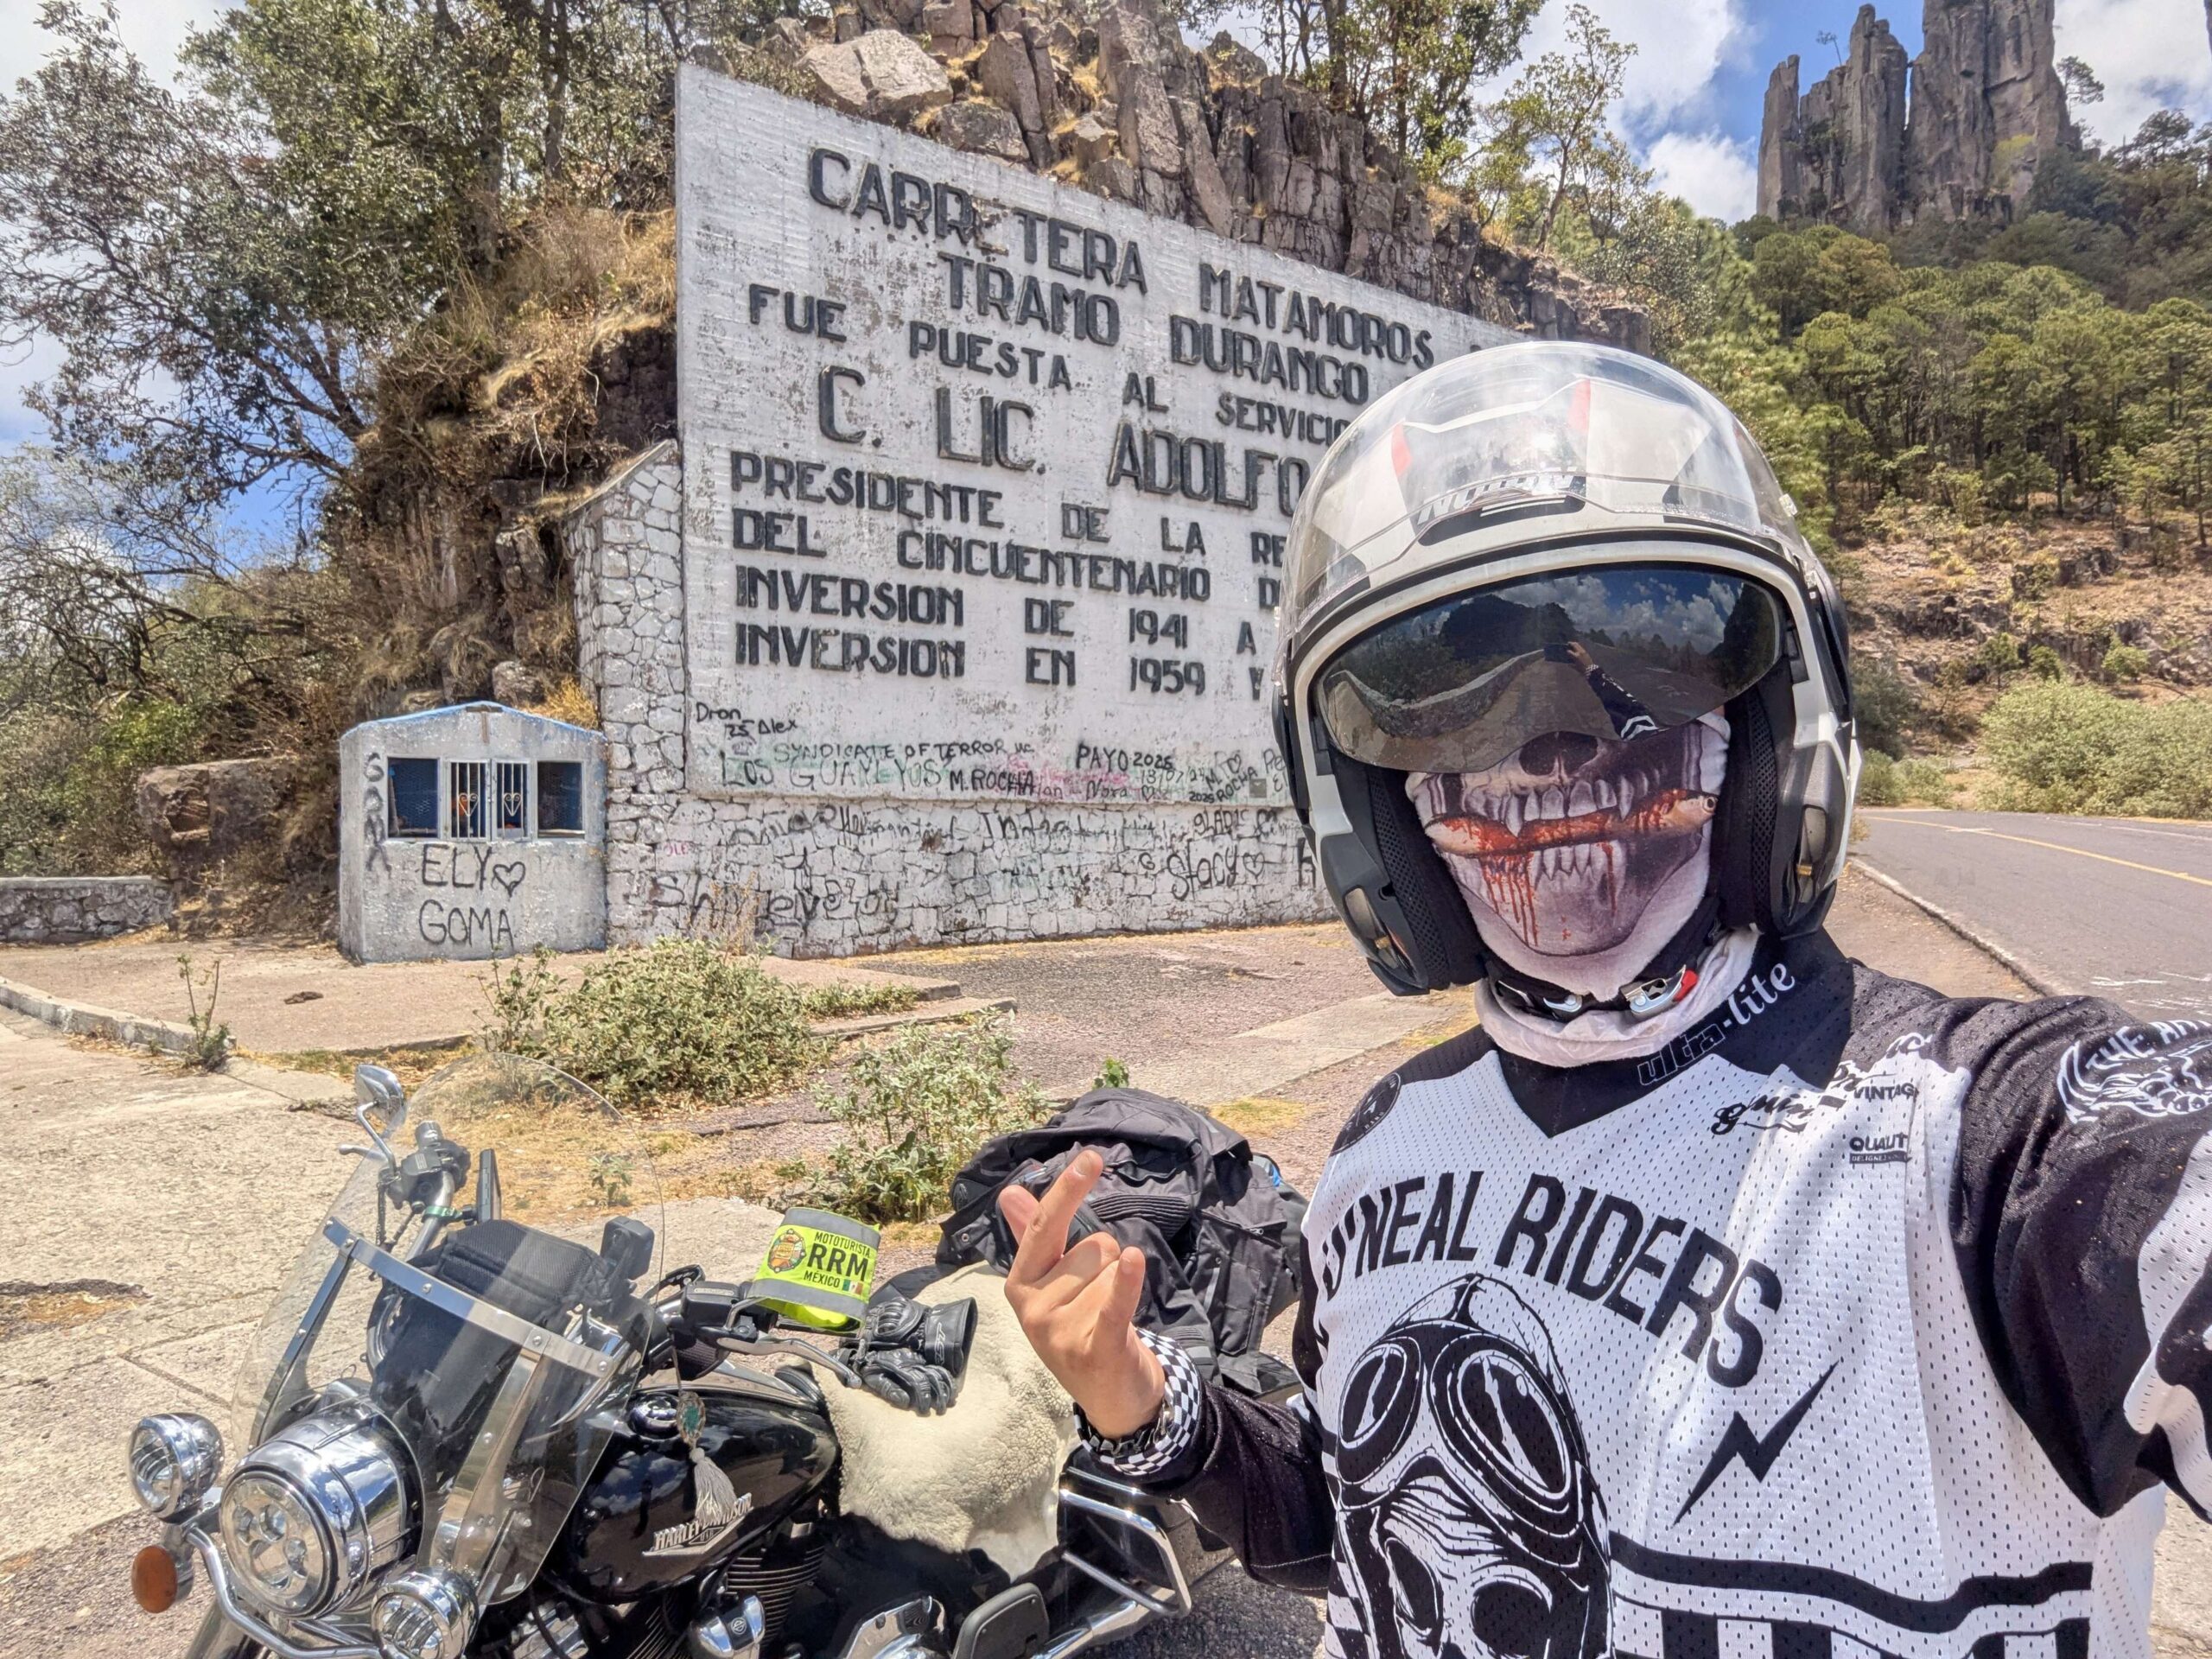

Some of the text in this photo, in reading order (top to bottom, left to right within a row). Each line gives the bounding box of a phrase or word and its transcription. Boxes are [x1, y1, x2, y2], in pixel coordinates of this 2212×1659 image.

[749, 283, 847, 342] FUE
[910, 321, 1071, 391] PUESTA
[1123, 372, 1169, 412] AL
[938, 251, 1369, 405] TRAMO DURANGO
[1199, 263, 1433, 371] MATAMOROS
[819, 365, 1310, 517] C. LIC. ADOLFO
[731, 450, 1004, 528] PRESIDENTE
[1062, 503, 1110, 543] DE
[1160, 517, 1206, 555] LA
[733, 507, 827, 557] DEL
[898, 531, 1210, 601] CINCUENTENARIO
[735, 565, 1256, 655] INVERSION DE 1941 A
[734, 622, 965, 678] INVERSION
[1026, 647, 1076, 686] EN
[1128, 657, 1205, 696] 1959
[905, 743, 930, 760] OF
[1076, 741, 1128, 772] PAYO
[422, 843, 493, 890] ELY
[418, 899, 514, 950] GOMA
[1853, 1083, 1916, 1101] VINTAG
[804, 1270, 841, 1287] MÉXICO
[807, 1243, 869, 1281] RRM
[815, 1231, 871, 1258] MOTOTURISTA
[1494, 1173, 1783, 1388] RIDERS
